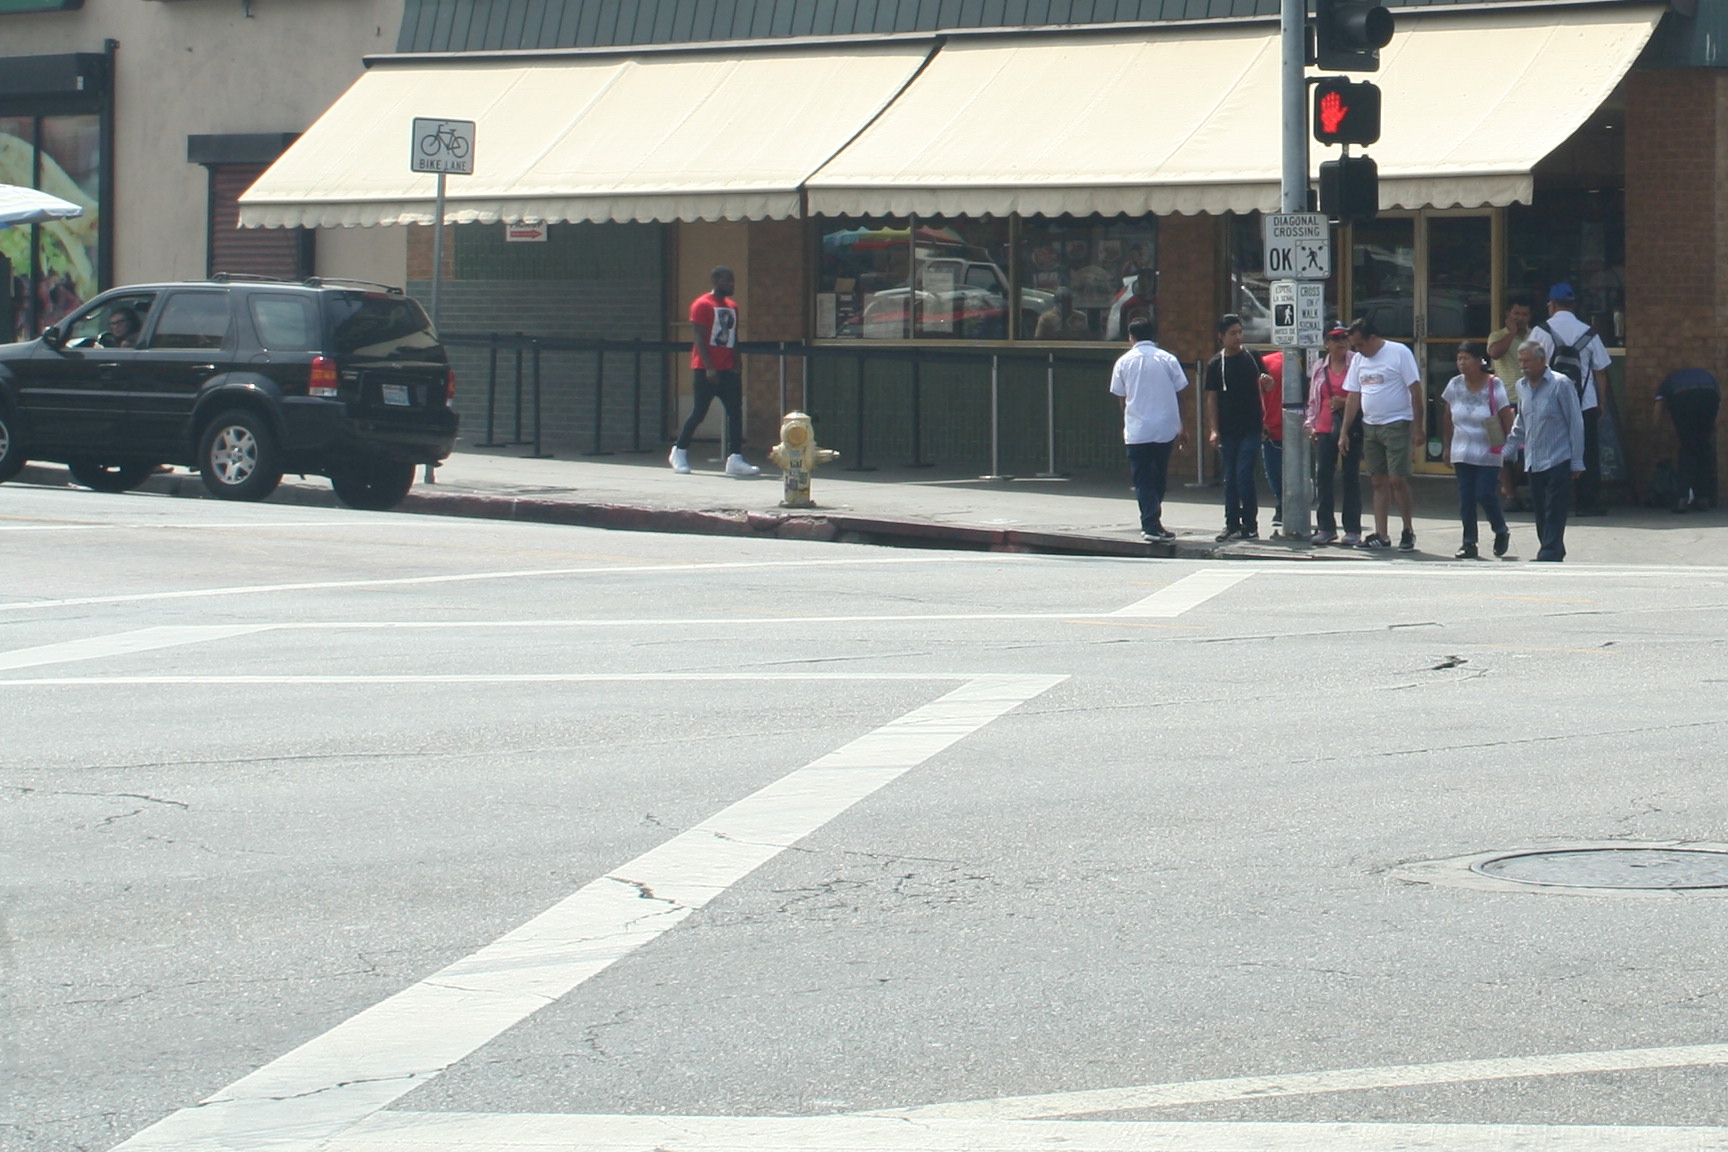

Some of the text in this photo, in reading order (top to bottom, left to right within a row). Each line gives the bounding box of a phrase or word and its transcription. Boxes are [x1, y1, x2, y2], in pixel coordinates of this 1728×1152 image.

[419, 158, 466, 172] BIKE LANE
[1273, 216, 1319, 227] DIAGONAL
[1273, 227, 1320, 237] CROSSING
[1269, 248, 1292, 271] OK
